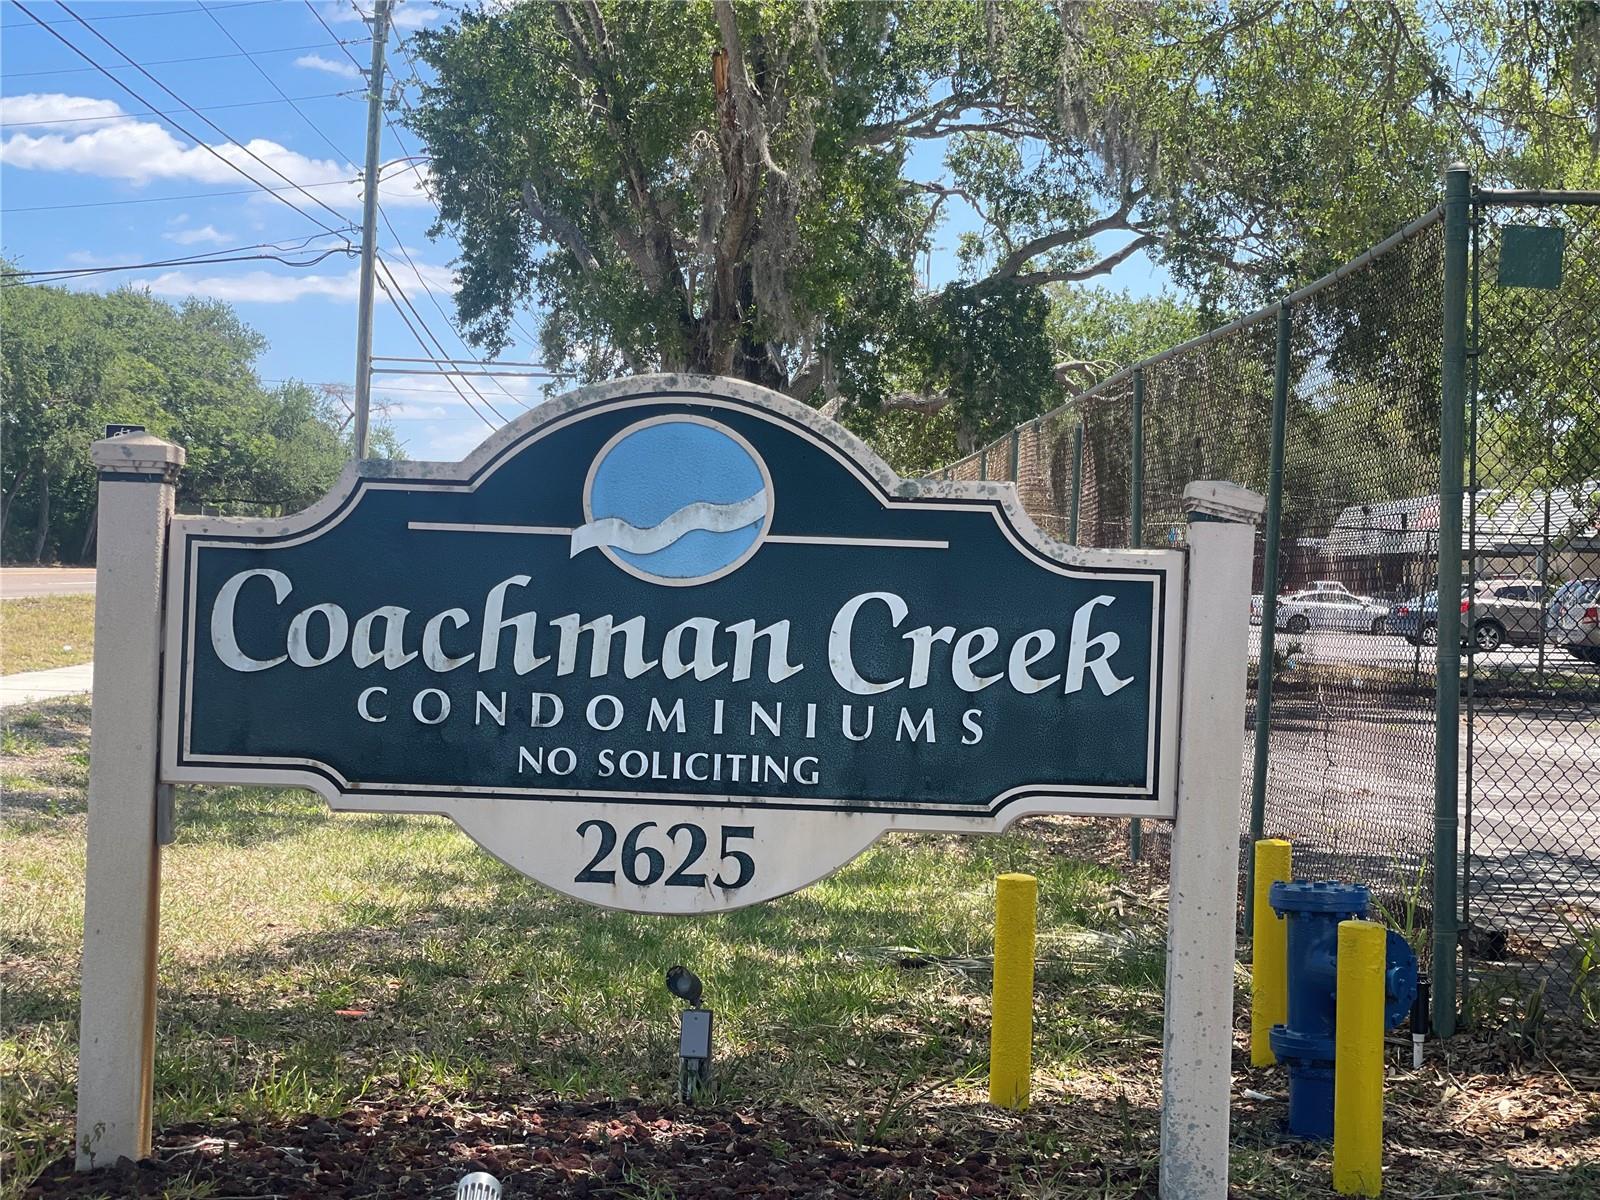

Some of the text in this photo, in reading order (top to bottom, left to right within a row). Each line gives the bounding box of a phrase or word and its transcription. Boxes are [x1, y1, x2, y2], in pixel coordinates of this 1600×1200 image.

[210, 568, 1135, 697] Coachman Creek
[357, 686, 984, 746] CONDOMINIUMS
[517, 745, 820, 785] NO SOLICITING
[575, 819, 756, 889] 2625
